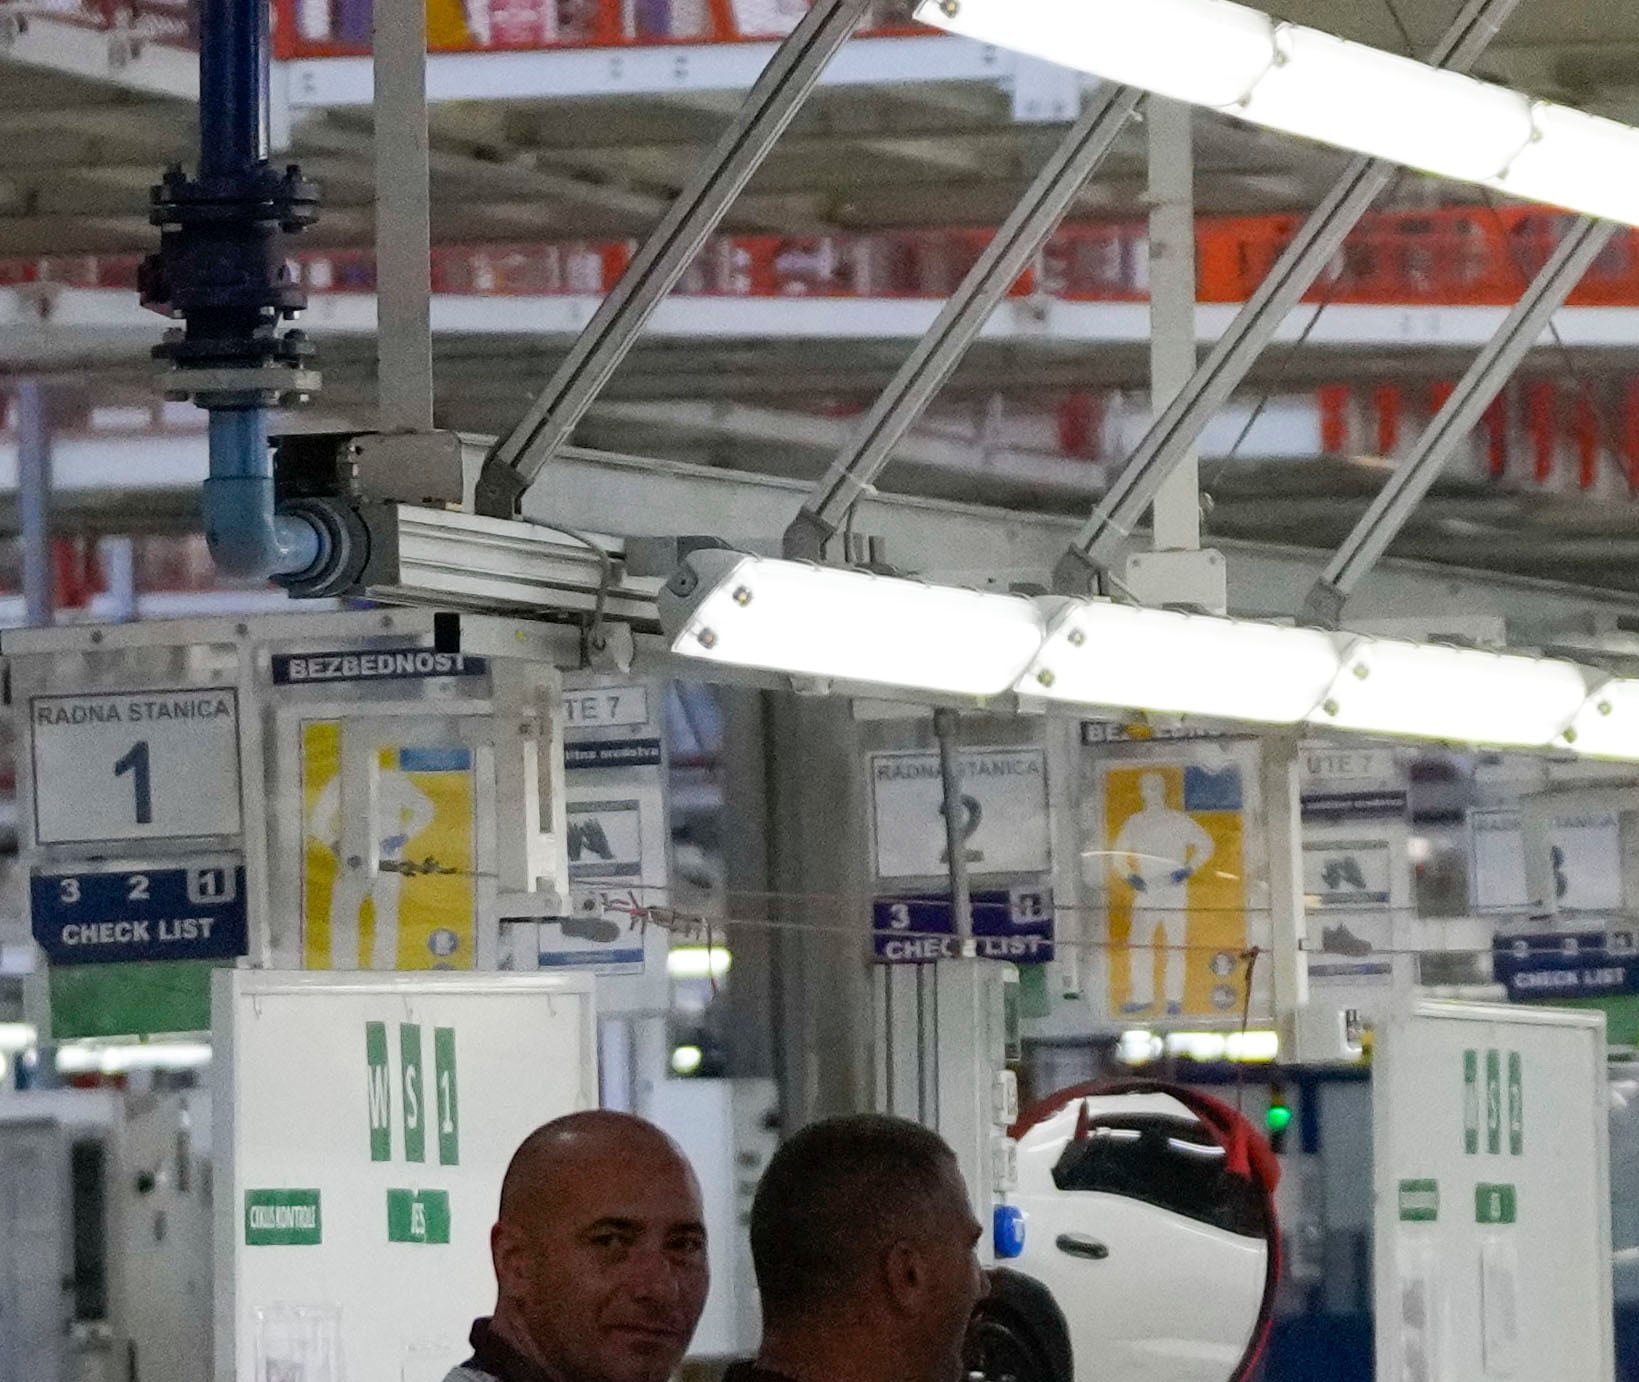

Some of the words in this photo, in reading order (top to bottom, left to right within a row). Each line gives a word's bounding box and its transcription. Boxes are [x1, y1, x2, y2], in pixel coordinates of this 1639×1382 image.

[288, 652, 465, 679] BEZBEDNOST
[37, 703, 122, 726] RADNA
[129, 699, 231, 723] STANICA
[562, 696, 597, 720] TE
[607, 696, 620, 718] 7
[114, 740, 152, 824] 1
[938, 794, 984, 865] 2
[60, 878, 82, 903] 3
[128, 874, 150, 900] 2
[889, 904, 911, 929] 3
[62, 919, 151, 946] CHECK
[158, 917, 214, 940] LIST
[885, 937, 953, 960] CHEC
[985, 935, 1043, 955] LIST
